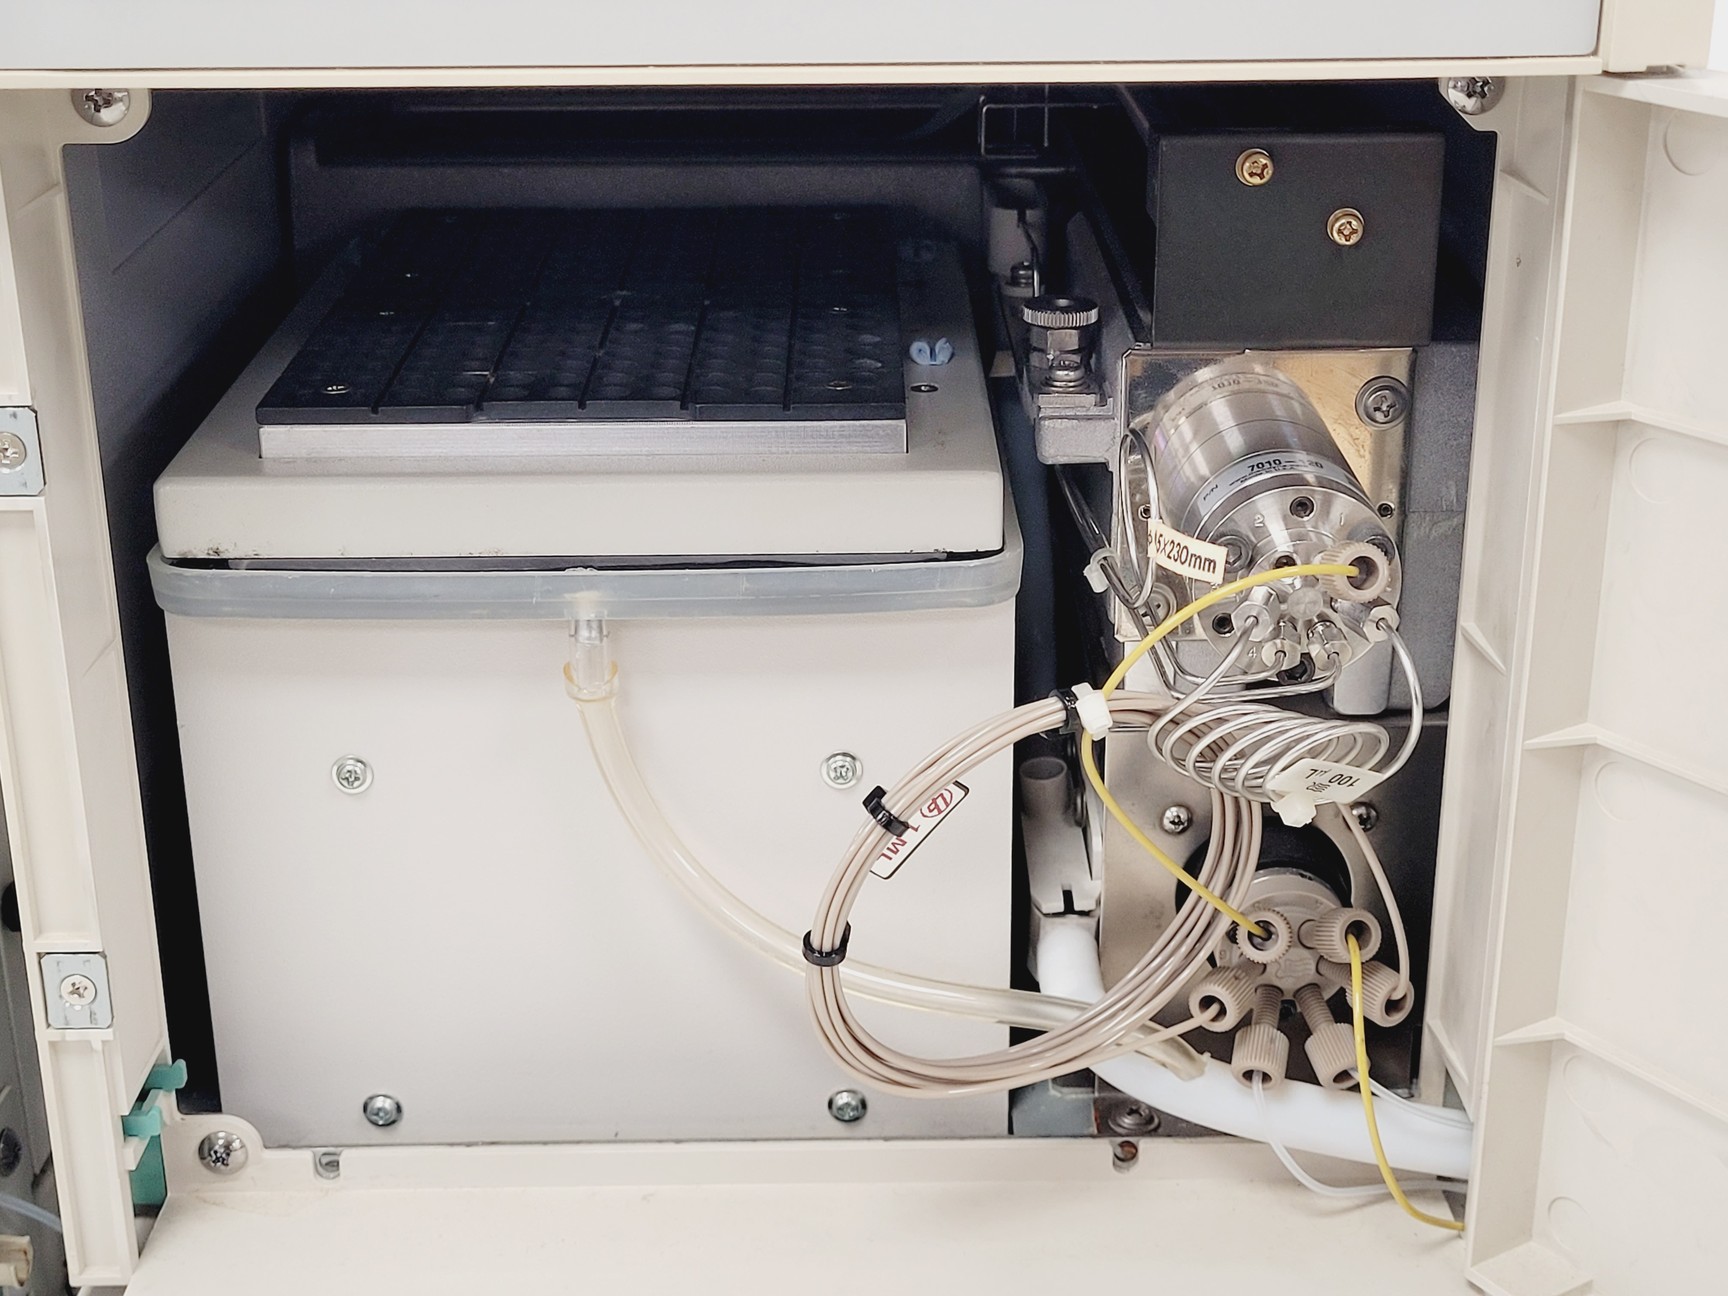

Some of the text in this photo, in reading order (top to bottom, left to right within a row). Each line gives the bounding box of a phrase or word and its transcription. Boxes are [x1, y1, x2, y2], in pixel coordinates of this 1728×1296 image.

[1254, 513, 1264, 527] 2
[1247, 646, 1258, 659] 4
[1327, 773, 1361, 788] 100
